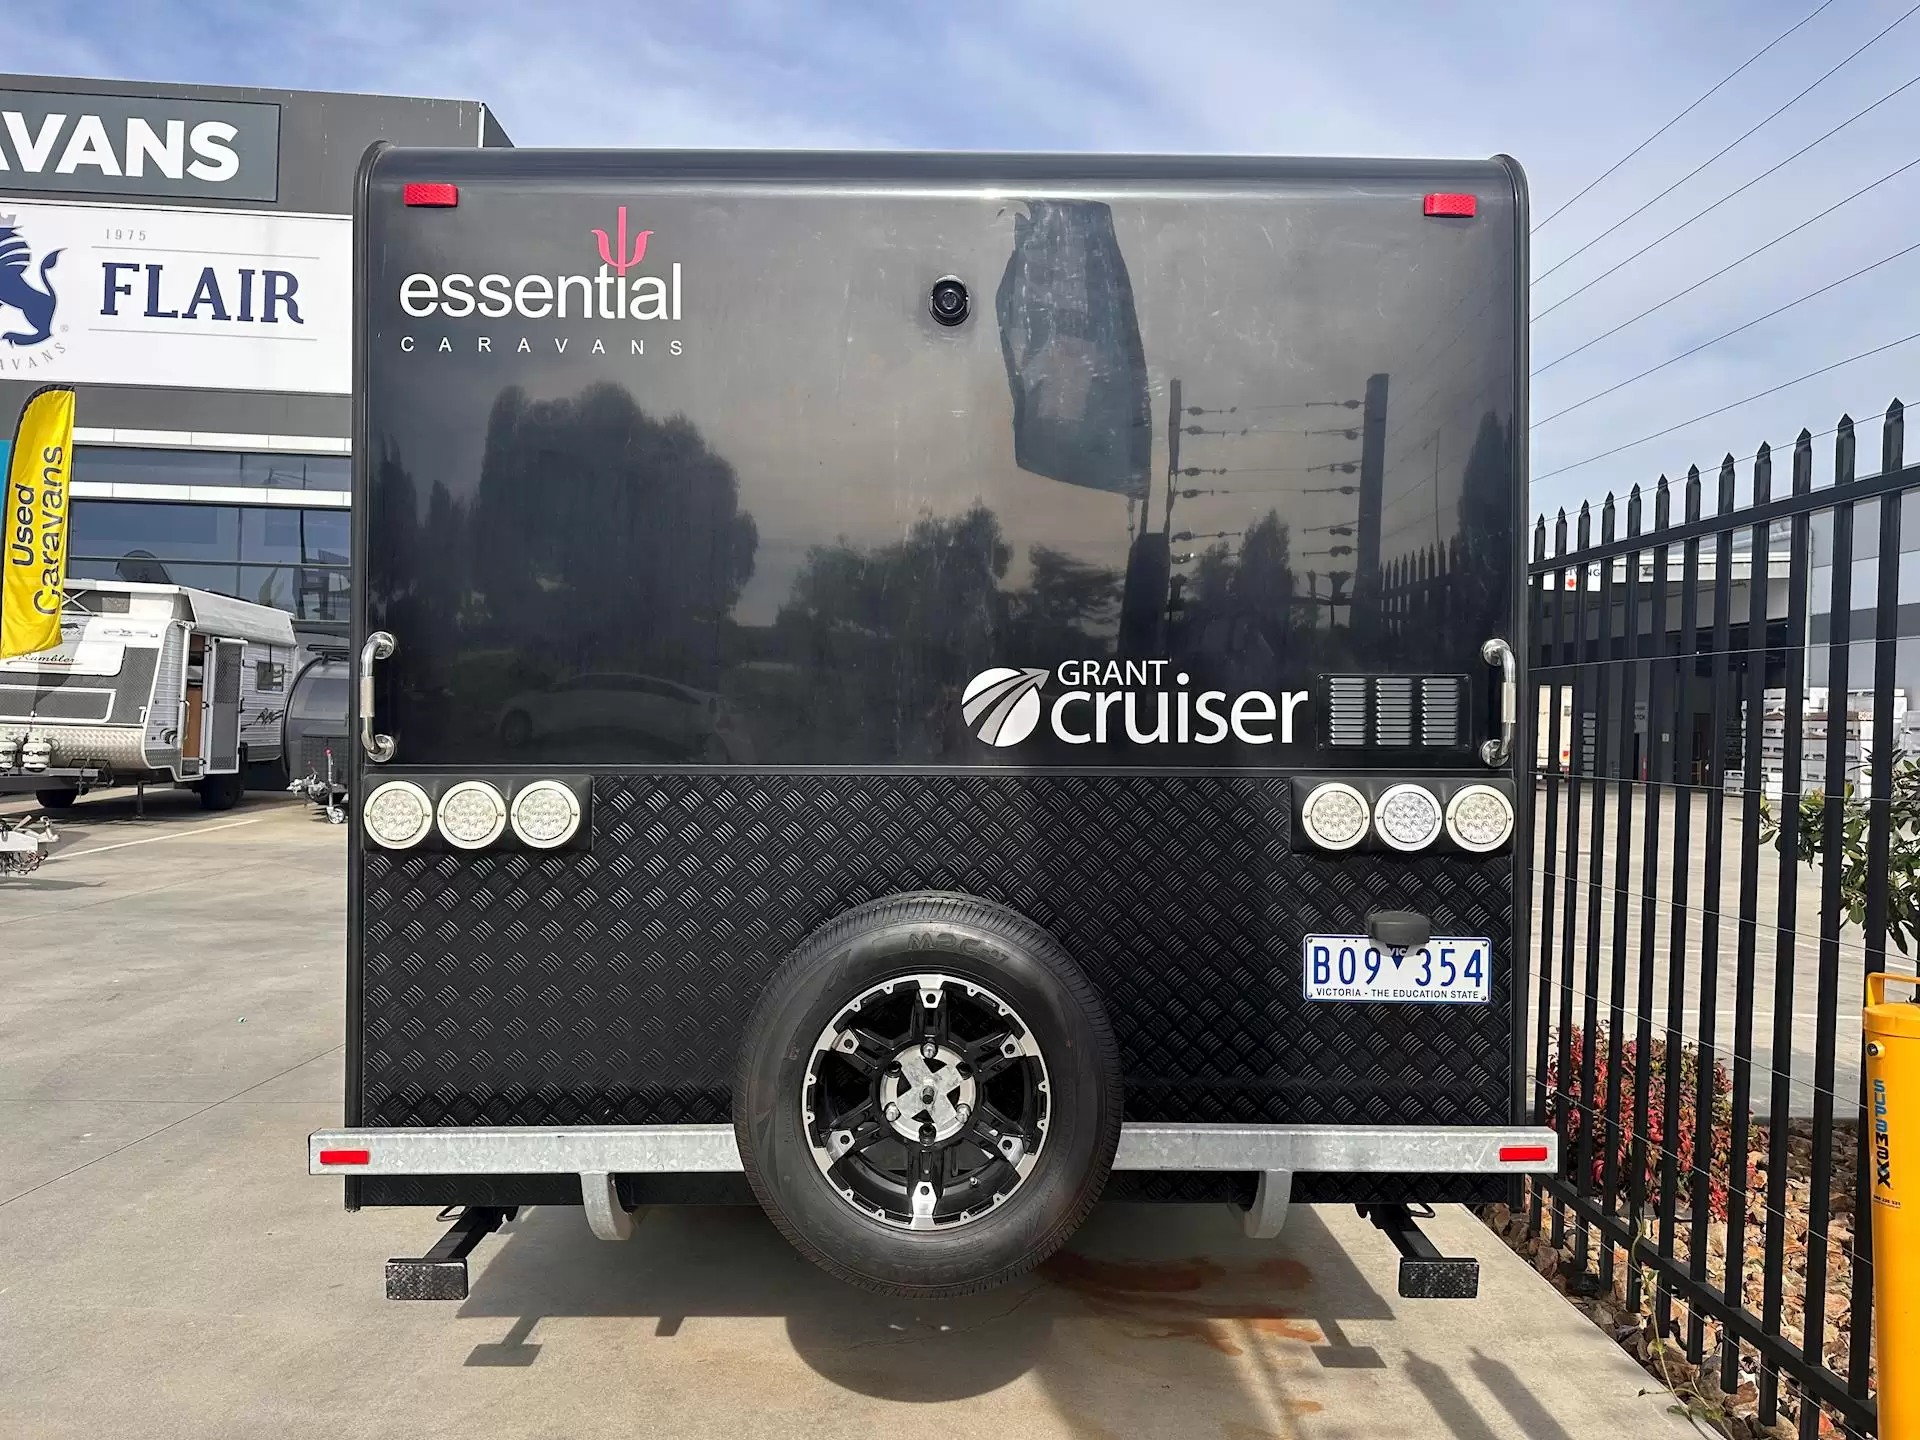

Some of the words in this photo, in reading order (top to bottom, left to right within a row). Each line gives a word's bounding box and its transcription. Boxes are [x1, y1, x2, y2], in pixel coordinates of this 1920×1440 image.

[105, 228, 147, 241] 1975
[100, 262, 304, 324] FLAIR
[399, 261, 682, 320] essential
[400, 336, 683, 355] CARAVANS
[12, 483, 35, 567] Used
[33, 446, 63, 615] Caravans
[1057, 660, 1168, 686] GRANT
[1050, 672, 1309, 744] cruiser
[1313, 946, 1381, 985] B09
[1415, 948, 1483, 987] 354
[1316, 988, 1361, 997] VICTORIA
[1371, 989, 1390, 998] THE
[1393, 989, 1448, 999] EDUCATION
[1450, 991, 1479, 999] STATE
